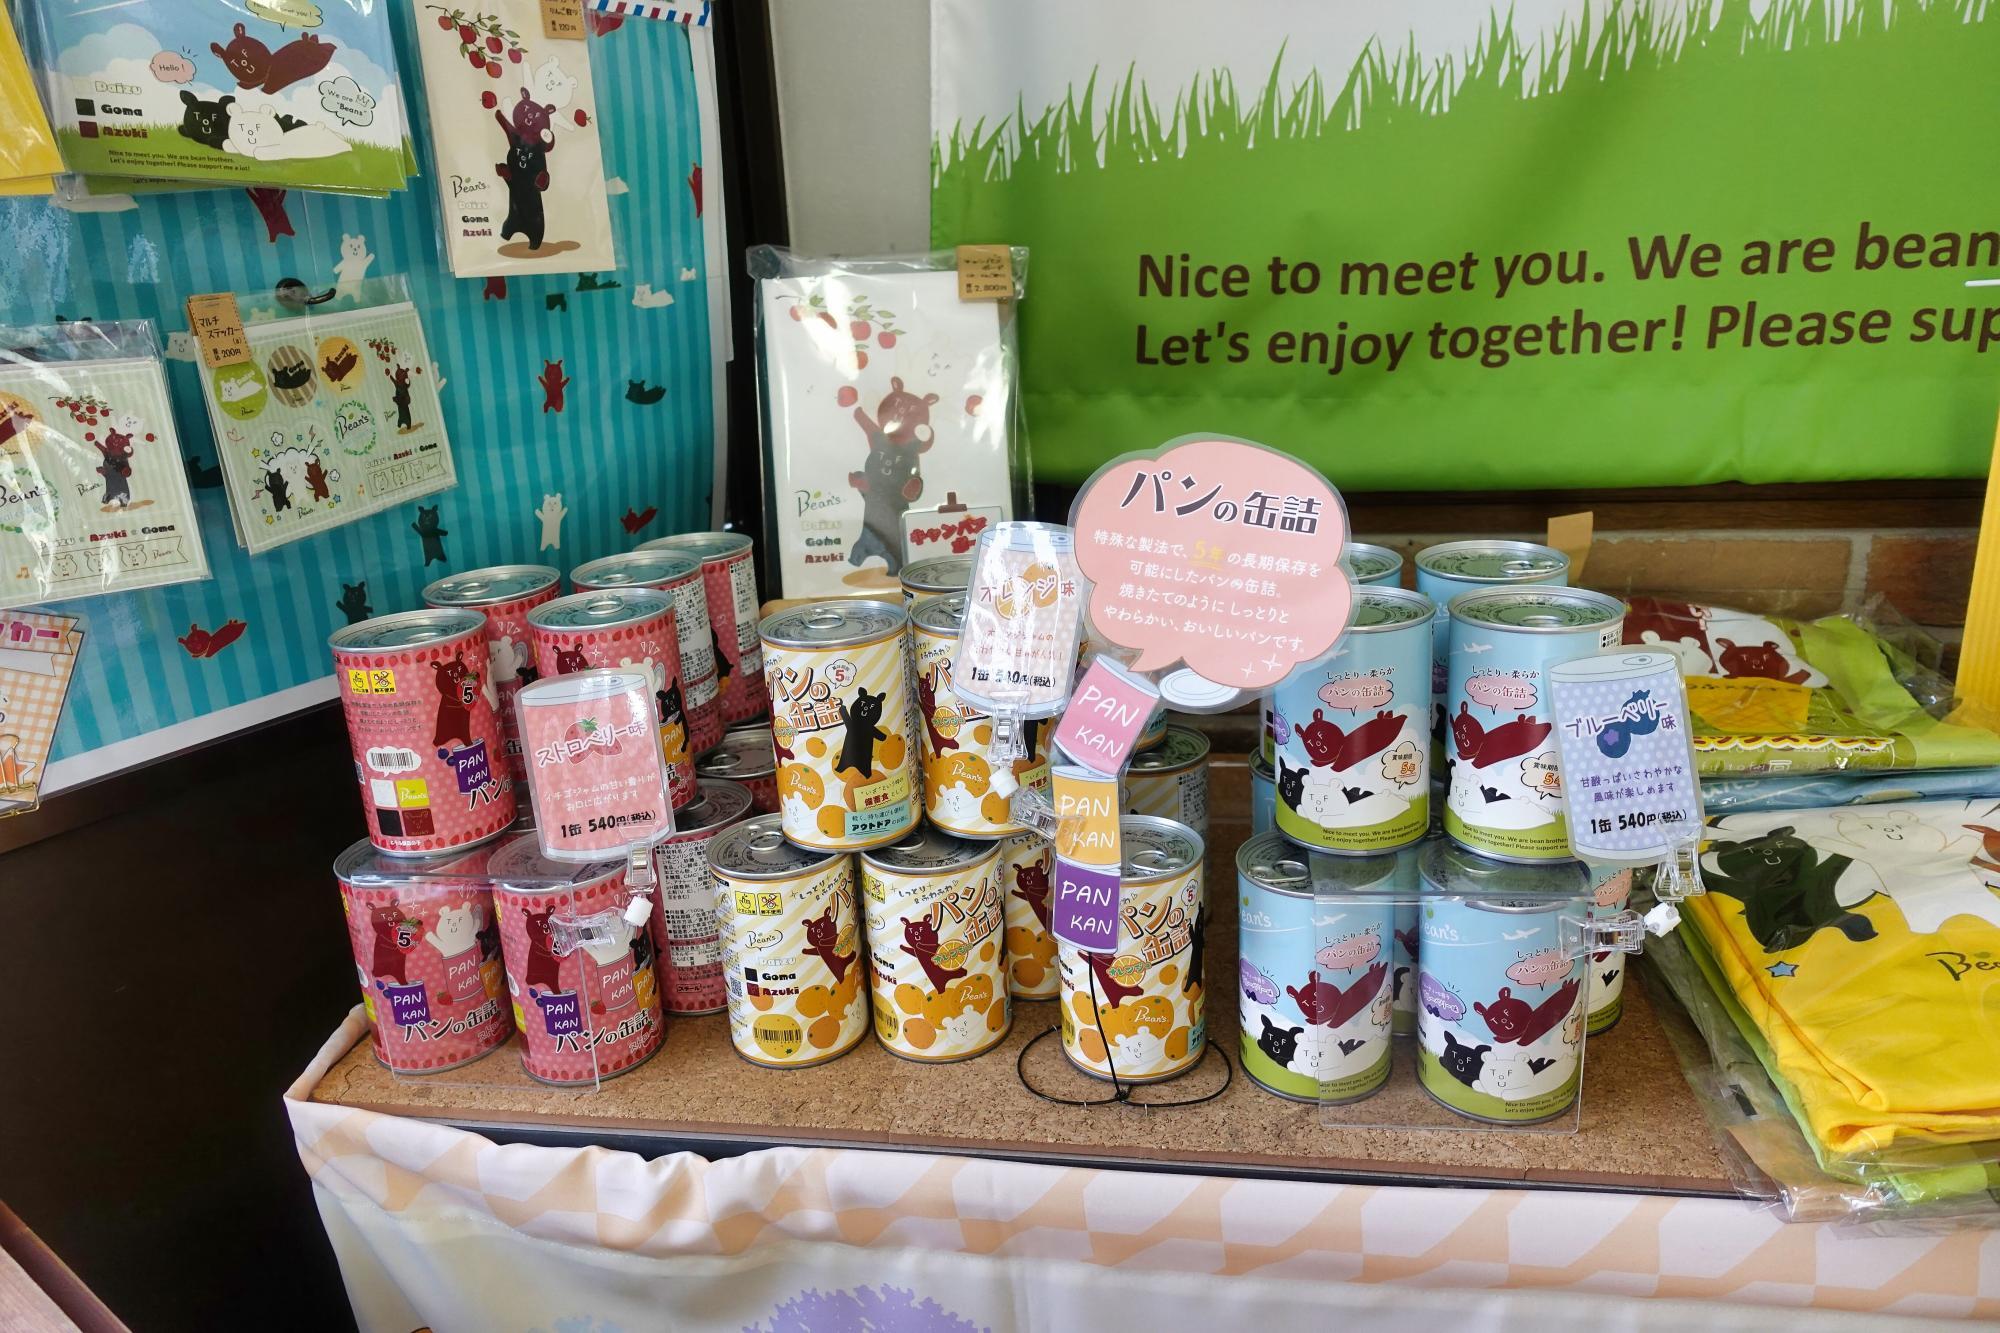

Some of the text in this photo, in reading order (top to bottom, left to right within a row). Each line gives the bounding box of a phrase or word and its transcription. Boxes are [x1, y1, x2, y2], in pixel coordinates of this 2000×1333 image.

[95, 80, 142, 95] Daizu
[101, 104, 143, 117] Goma
[102, 126, 148, 139] Azuki
[449, 174, 487, 199] Bean's
[462, 215, 489, 223] Goma
[463, 229, 493, 237] Azuki
[1135, 221, 2000, 298] Nice to meet you. We are bean
[198, 316, 220, 328] マルチ
[206, 327, 241, 339] ステッカー
[1134, 322, 1251, 367] Let's
[1266, 323, 1412, 376] enjoy
[1427, 304, 1687, 369] together!
[1706, 301, 1892, 350] Please
[335, 413, 370, 440] Bean's
[419, 441, 438, 453] Goma
[793, 489, 842, 518] Bean's
[1119, 469, 1323, 536] パンの缶詰
[89, 524, 176, 542] Azuki Goma
[805, 537, 841, 547] Goma
[805, 552, 845, 564] Azuki
[1129, 559, 1282, 599] 可能にしたパンの缶詰。
[0, 619, 60, 643] カー
[1103, 604, 1306, 654] やわらかい、おいしいパンです。
[1326, 667, 1395, 681] しっとり・柔らか
[1472, 665, 1541, 680] しっとり・柔らか
[768, 666, 831, 702] パンの
[1328, 685, 1385, 698] パンの缶詰
[1471, 681, 1528, 700] パンの缶詰
[463, 686, 475, 704] 5
[789, 696, 844, 734] 缶詰
[1076, 684, 1141, 729] PAN
[1565, 695, 1678, 739] ブルーベリー味
[536, 720, 648, 769] ストロベリー味
[1074, 724, 1124, 759] KAN
[459, 750, 485, 773] PAN
[951, 759, 984, 783] Bean's
[466, 766, 489, 786] KAN
[789, 770, 819, 796] Bean's
[1580, 765, 1683, 788] 甘酸っぱいさわやかな
[1593, 781, 1676, 803] 風味が楽しめます
[1059, 794, 1111, 818] PAN
[560, 823, 582, 838] 1缶
[1590, 807, 1688, 835] 1缶 540円(税込)
[1071, 830, 1116, 850] KAN
[799, 880, 826, 900] しっとり
[898, 885, 927, 898] しっとり
[1060, 879, 1113, 908] PAN
[930, 877, 998, 932] パンの
[964, 898, 1004, 944] 缶詰
[1070, 914, 1114, 936] KAN
[398, 931, 412, 949] 5
[747, 930, 777, 947] Bean's
[1141, 918, 1193, 966] 缶詰
[1423, 924, 1460, 942] ean's
[449, 954, 476, 980] PAN
[602, 964, 630, 989] PAN
[761, 972, 797, 981] Goma
[457, 972, 480, 993] KAN
[611, 979, 634, 1001] KAN
[761, 987, 800, 997] Azuki
[393, 991, 423, 1008] PAN
[959, 985, 988, 1004] Bean's
[402, 1006, 427, 1022] KAN
[546, 1001, 575, 1016] PAN
[1133, 1005, 1168, 1024] Bean's
[404, 999, 501, 1044] パンの缶詰
[553, 1017, 579, 1031] KAN
[555, 1007, 652, 1053] パンの缶詰
